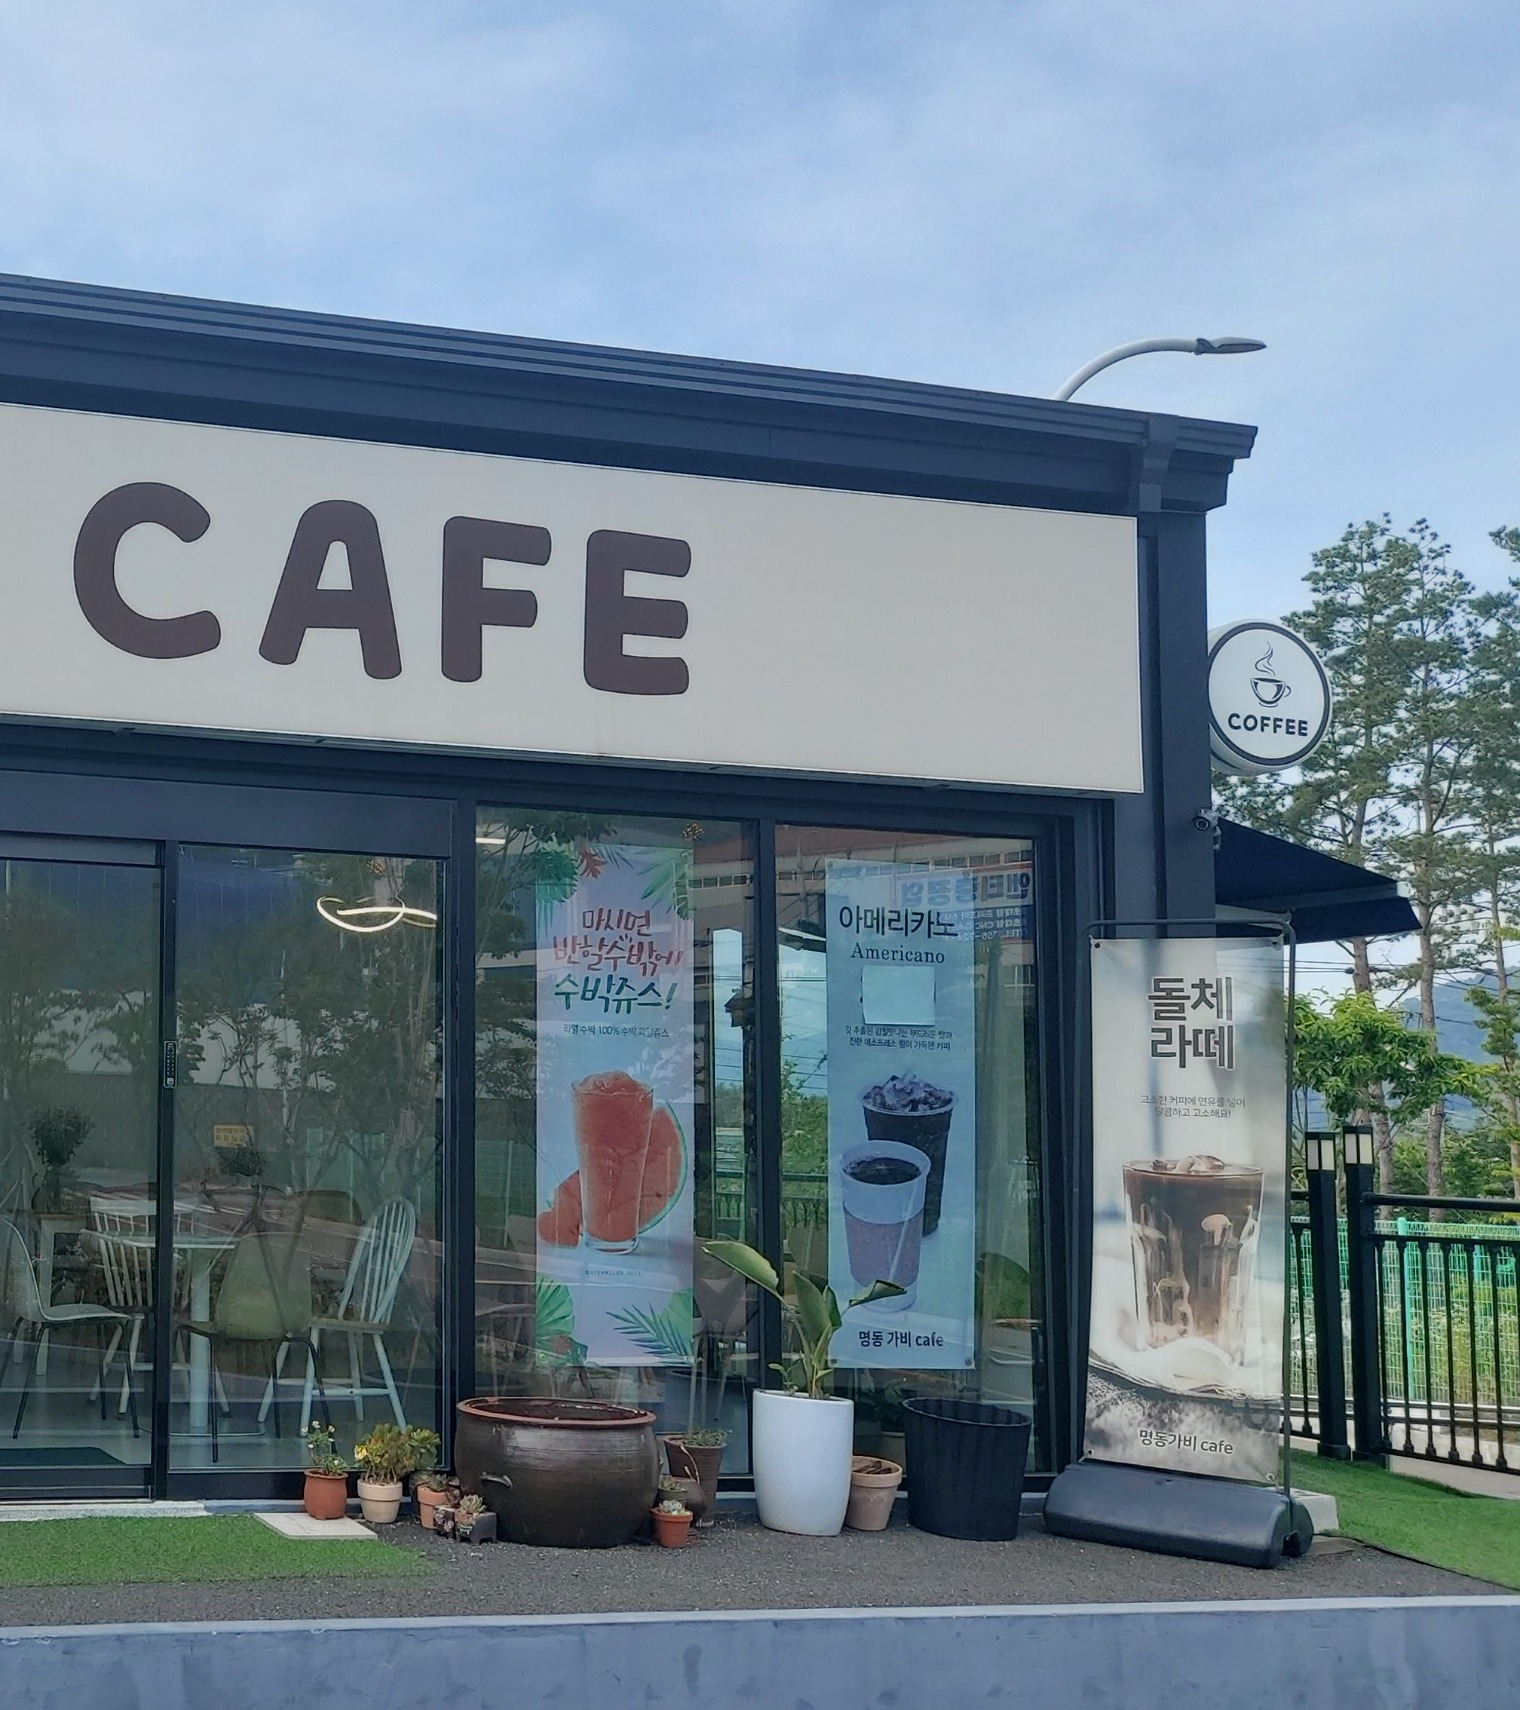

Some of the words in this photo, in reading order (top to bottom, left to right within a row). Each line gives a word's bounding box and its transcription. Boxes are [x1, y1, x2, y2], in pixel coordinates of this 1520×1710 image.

[73, 481, 691, 696] CAFE
[1227, 712, 1309, 737] COFFEE
[582, 907, 653, 937] 마시면
[839, 905, 959, 939] 아메리카노
[851, 942, 945, 964] Americano
[554, 973, 678, 1014] 수박쥬스!
[1148, 976, 1233, 1021] 돌체
[580, 1024, 596, 1035] 수박
[598, 1025, 620, 1035] 100%
[1151, 1025, 1234, 1069] 라떼
[1140, 1095, 1167, 1104] 고소한
[1169, 1095, 1197, 1106] 커피에
[1192, 1108, 1231, 1119] 고소해요!
[859, 1330, 884, 1347] 명동
[887, 1330, 912, 1348] 가비
[915, 1331, 944, 1347] cafe
[1139, 1429, 1197, 1452] 명동가비
[1200, 1440, 1234, 1455] cafe
